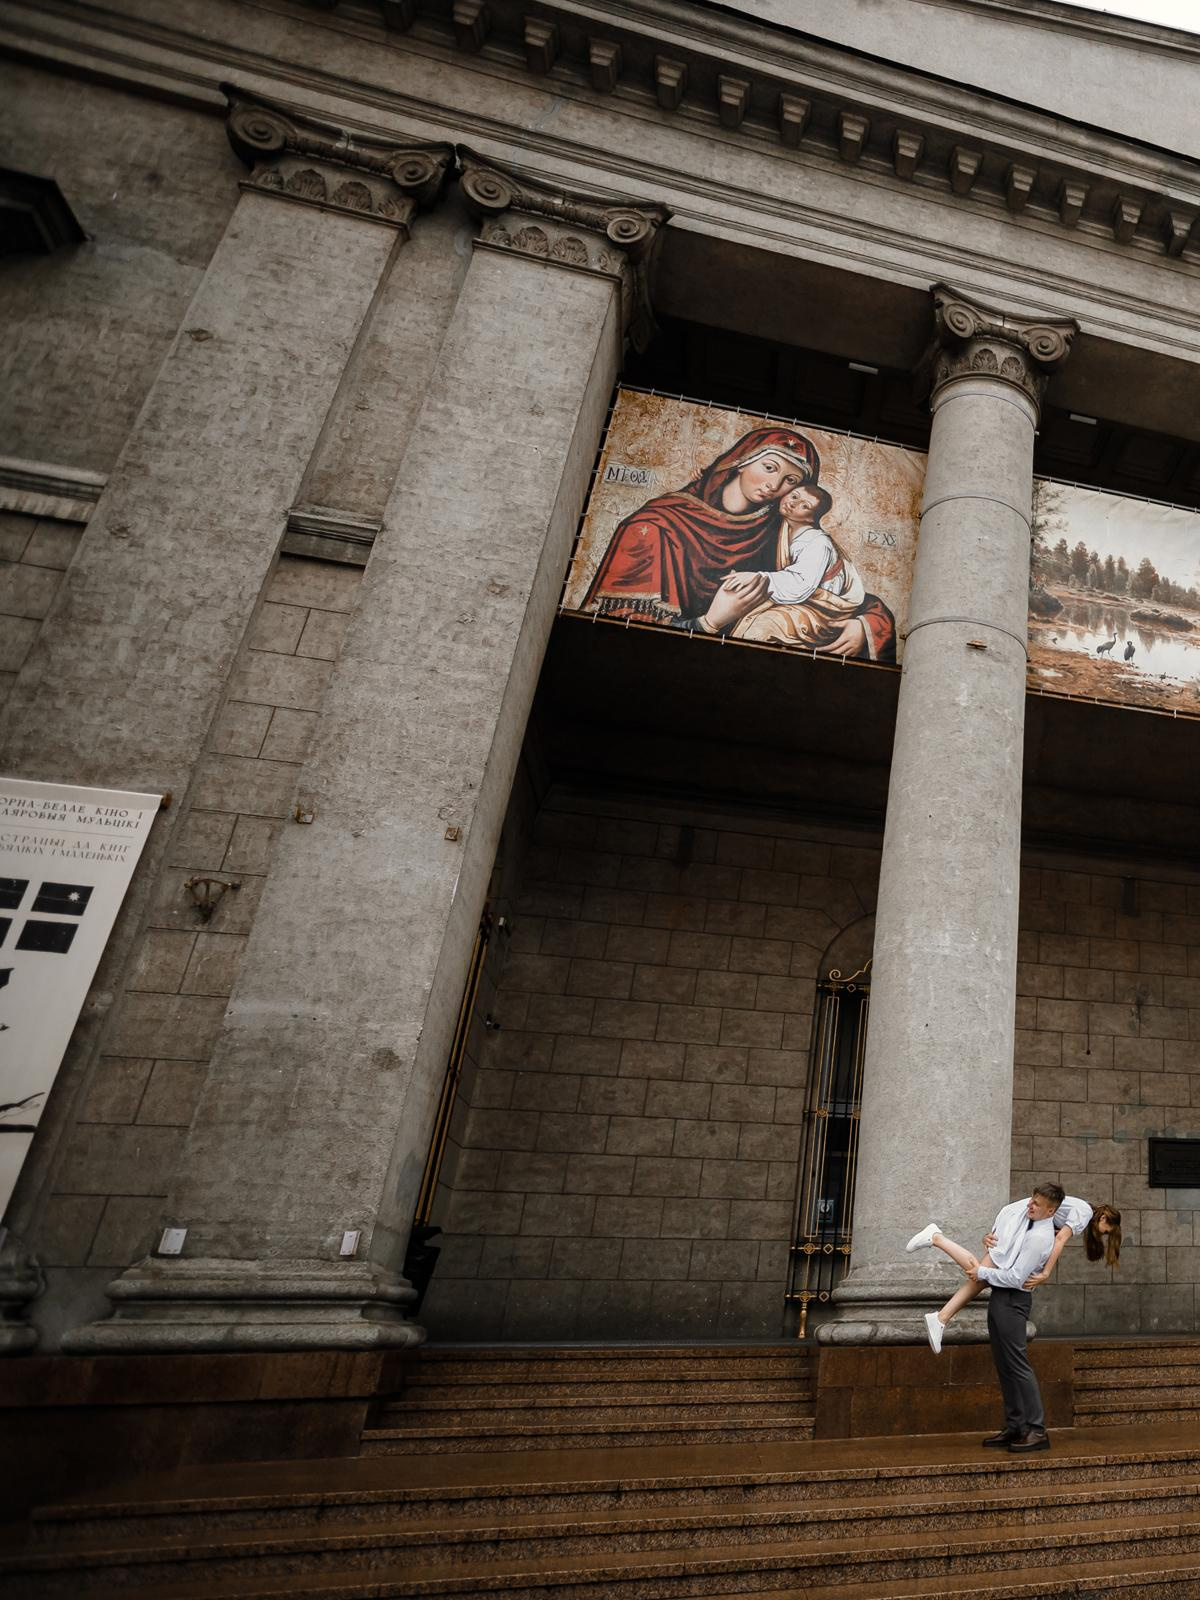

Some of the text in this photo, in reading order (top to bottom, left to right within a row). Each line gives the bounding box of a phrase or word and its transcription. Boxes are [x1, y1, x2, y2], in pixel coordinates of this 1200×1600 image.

[95, 807, 129, 817] КІНО
[76, 815, 140, 829] МУЛЬЦІКІ
[100, 843, 131, 853] КНІГ
